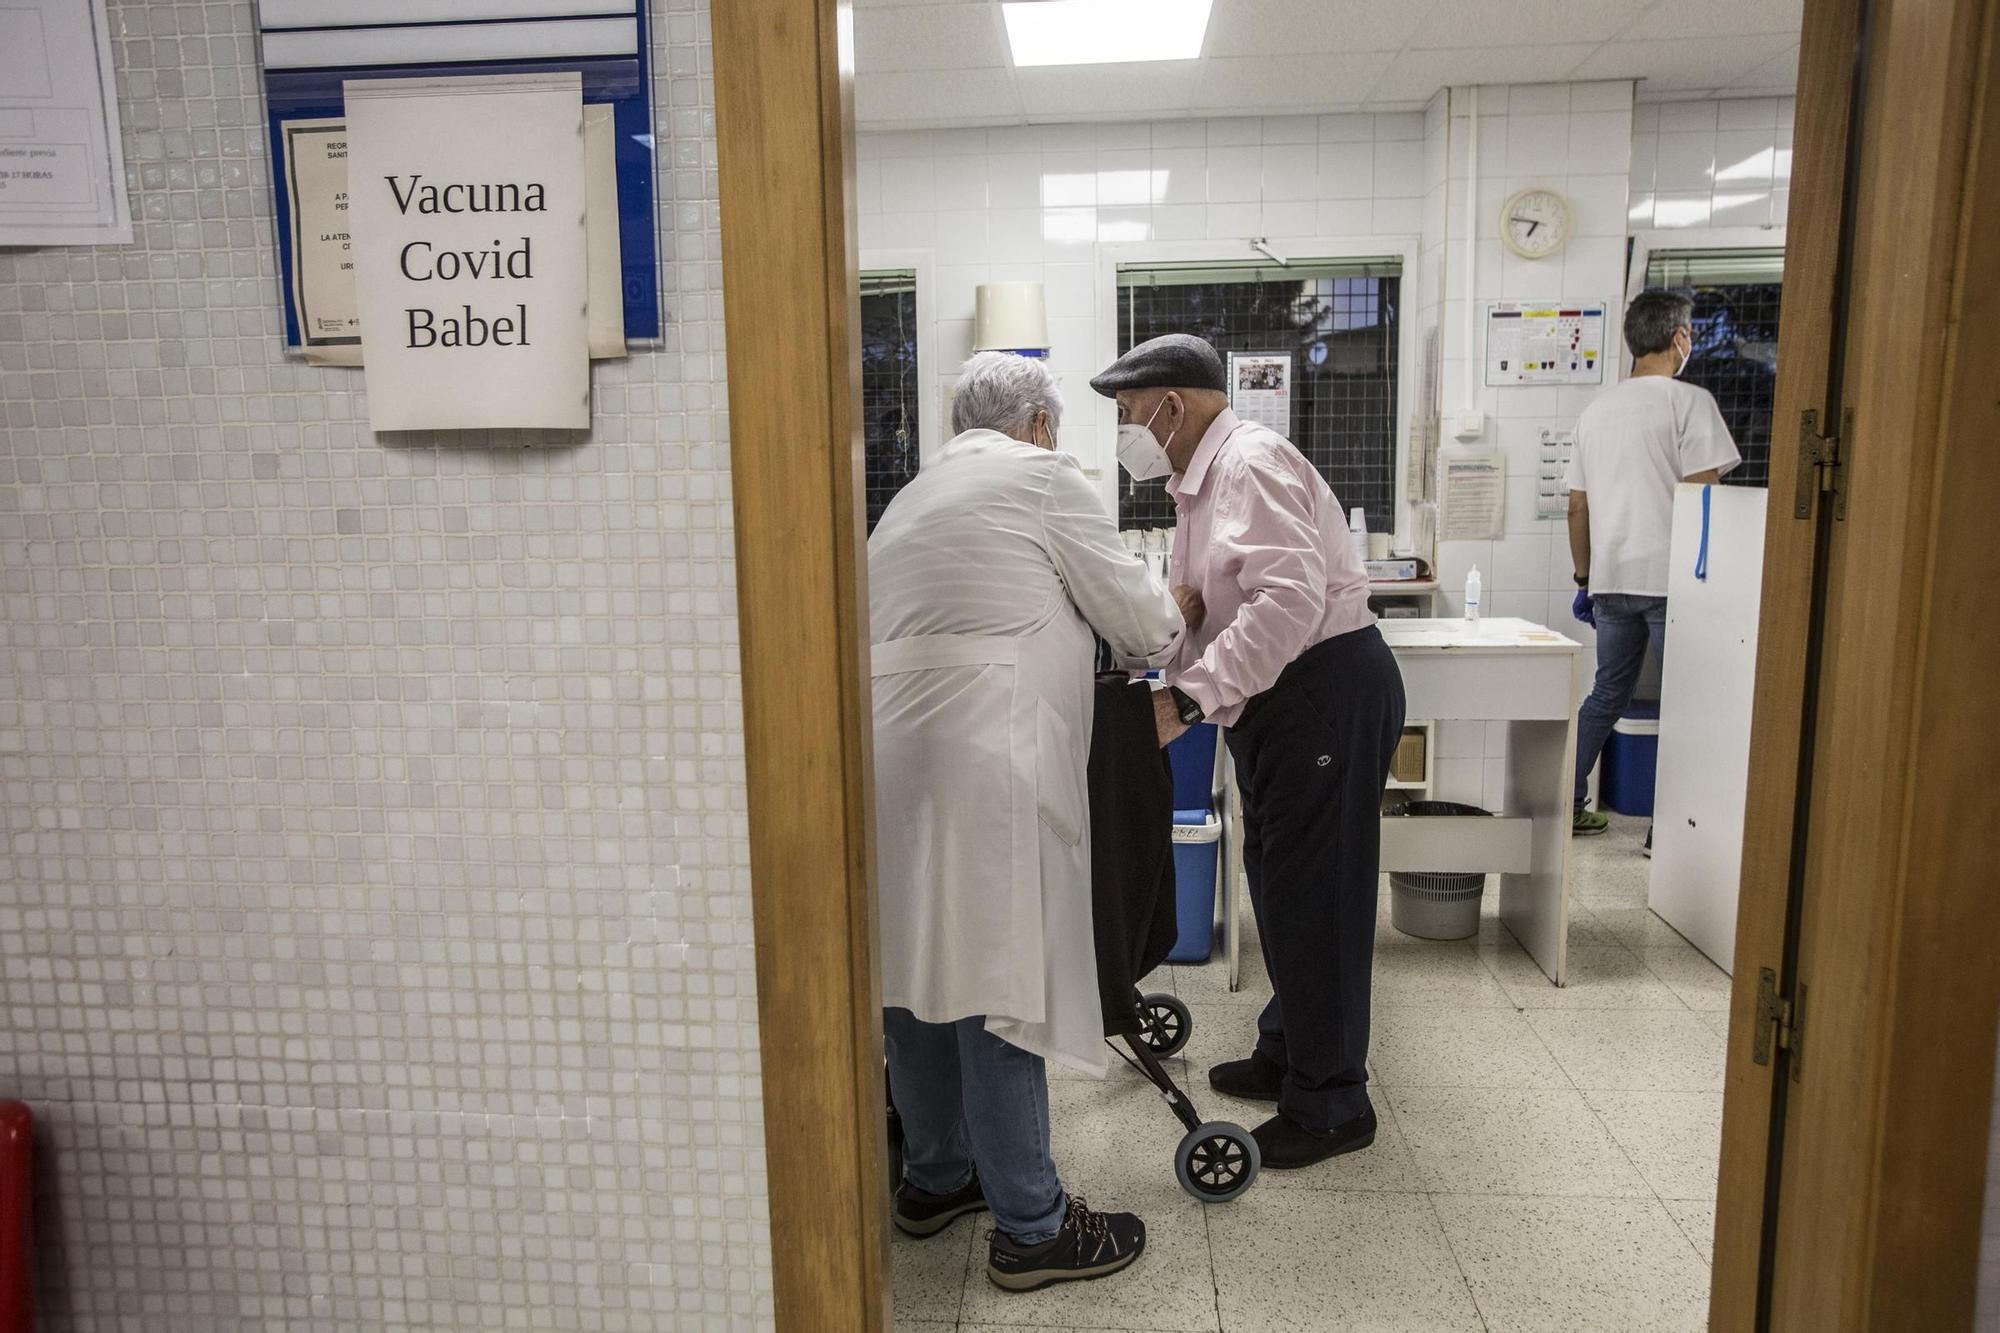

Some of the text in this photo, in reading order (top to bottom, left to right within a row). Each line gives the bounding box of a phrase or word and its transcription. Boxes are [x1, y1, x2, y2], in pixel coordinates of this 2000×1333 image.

[384, 175, 548, 216] Vacuna
[400, 237, 534, 281] Covid
[404, 304, 531, 348] Babel
